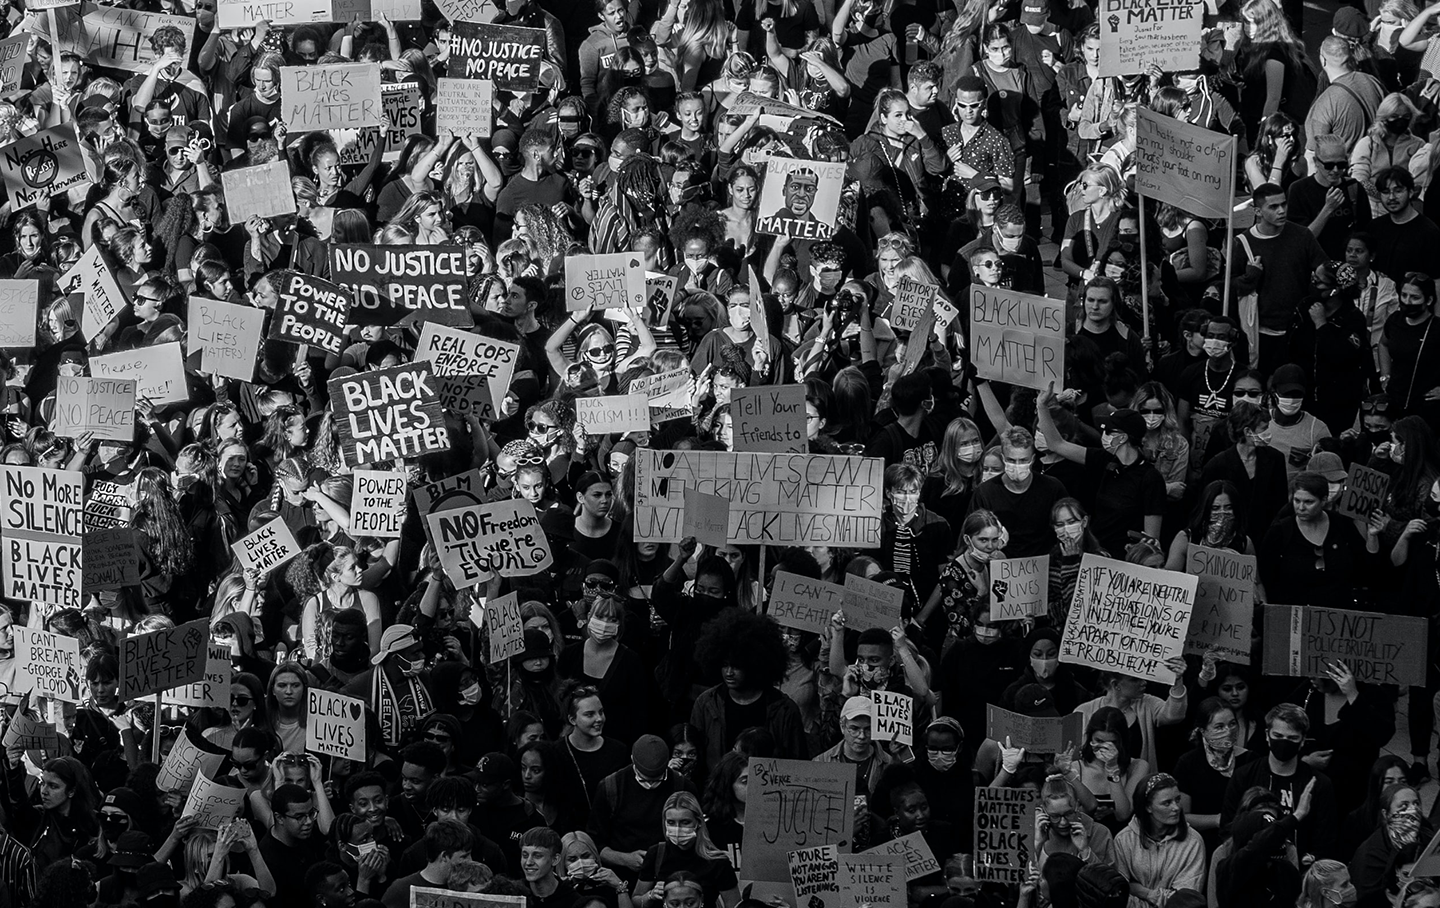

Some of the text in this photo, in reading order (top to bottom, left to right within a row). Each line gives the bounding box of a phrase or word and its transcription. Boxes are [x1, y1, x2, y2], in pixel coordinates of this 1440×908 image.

[482, 41, 541, 59] JUSTICE
[466, 58, 531, 80] NO PEACE
[1204, 143, 1226, 163] chip
[759, 217, 831, 238] MATTER!
[336, 250, 464, 275] NO JUSTICE
[289, 277, 347, 309] POWER
[387, 284, 464, 309] PEACE
[281, 295, 345, 324] TO THE
[282, 319, 344, 352] PEOPLE
[344, 371, 434, 411] BLACK
[350, 401, 428, 437] LIVES
[355, 429, 449, 464] MATTER
[43, 474, 81, 505] MORE
[359, 478, 404, 495] POWER
[363, 496, 393, 508] TO THE
[8, 499, 82, 536] SILENCE
[355, 513, 399, 531] PEOPLE
[1001, 560, 1039, 580] BLACK
[1009, 579, 1040, 599] LIVES
[37, 678, 67, 694] FLOYD
[310, 692, 348, 718] BLACK
[874, 693, 911, 707] BLACK
[878, 706, 909, 720] LIVES
[315, 719, 354, 747] LIVES
[877, 720, 911, 736] MATTER
[318, 742, 348, 757] MATTER
[978, 789, 1034, 802] ALL LIVES
[978, 801, 1026, 815] MATTER
[977, 813, 1020, 830] ONCE
[978, 830, 1029, 851] BLACK
[977, 866, 1026, 883] MATTER
